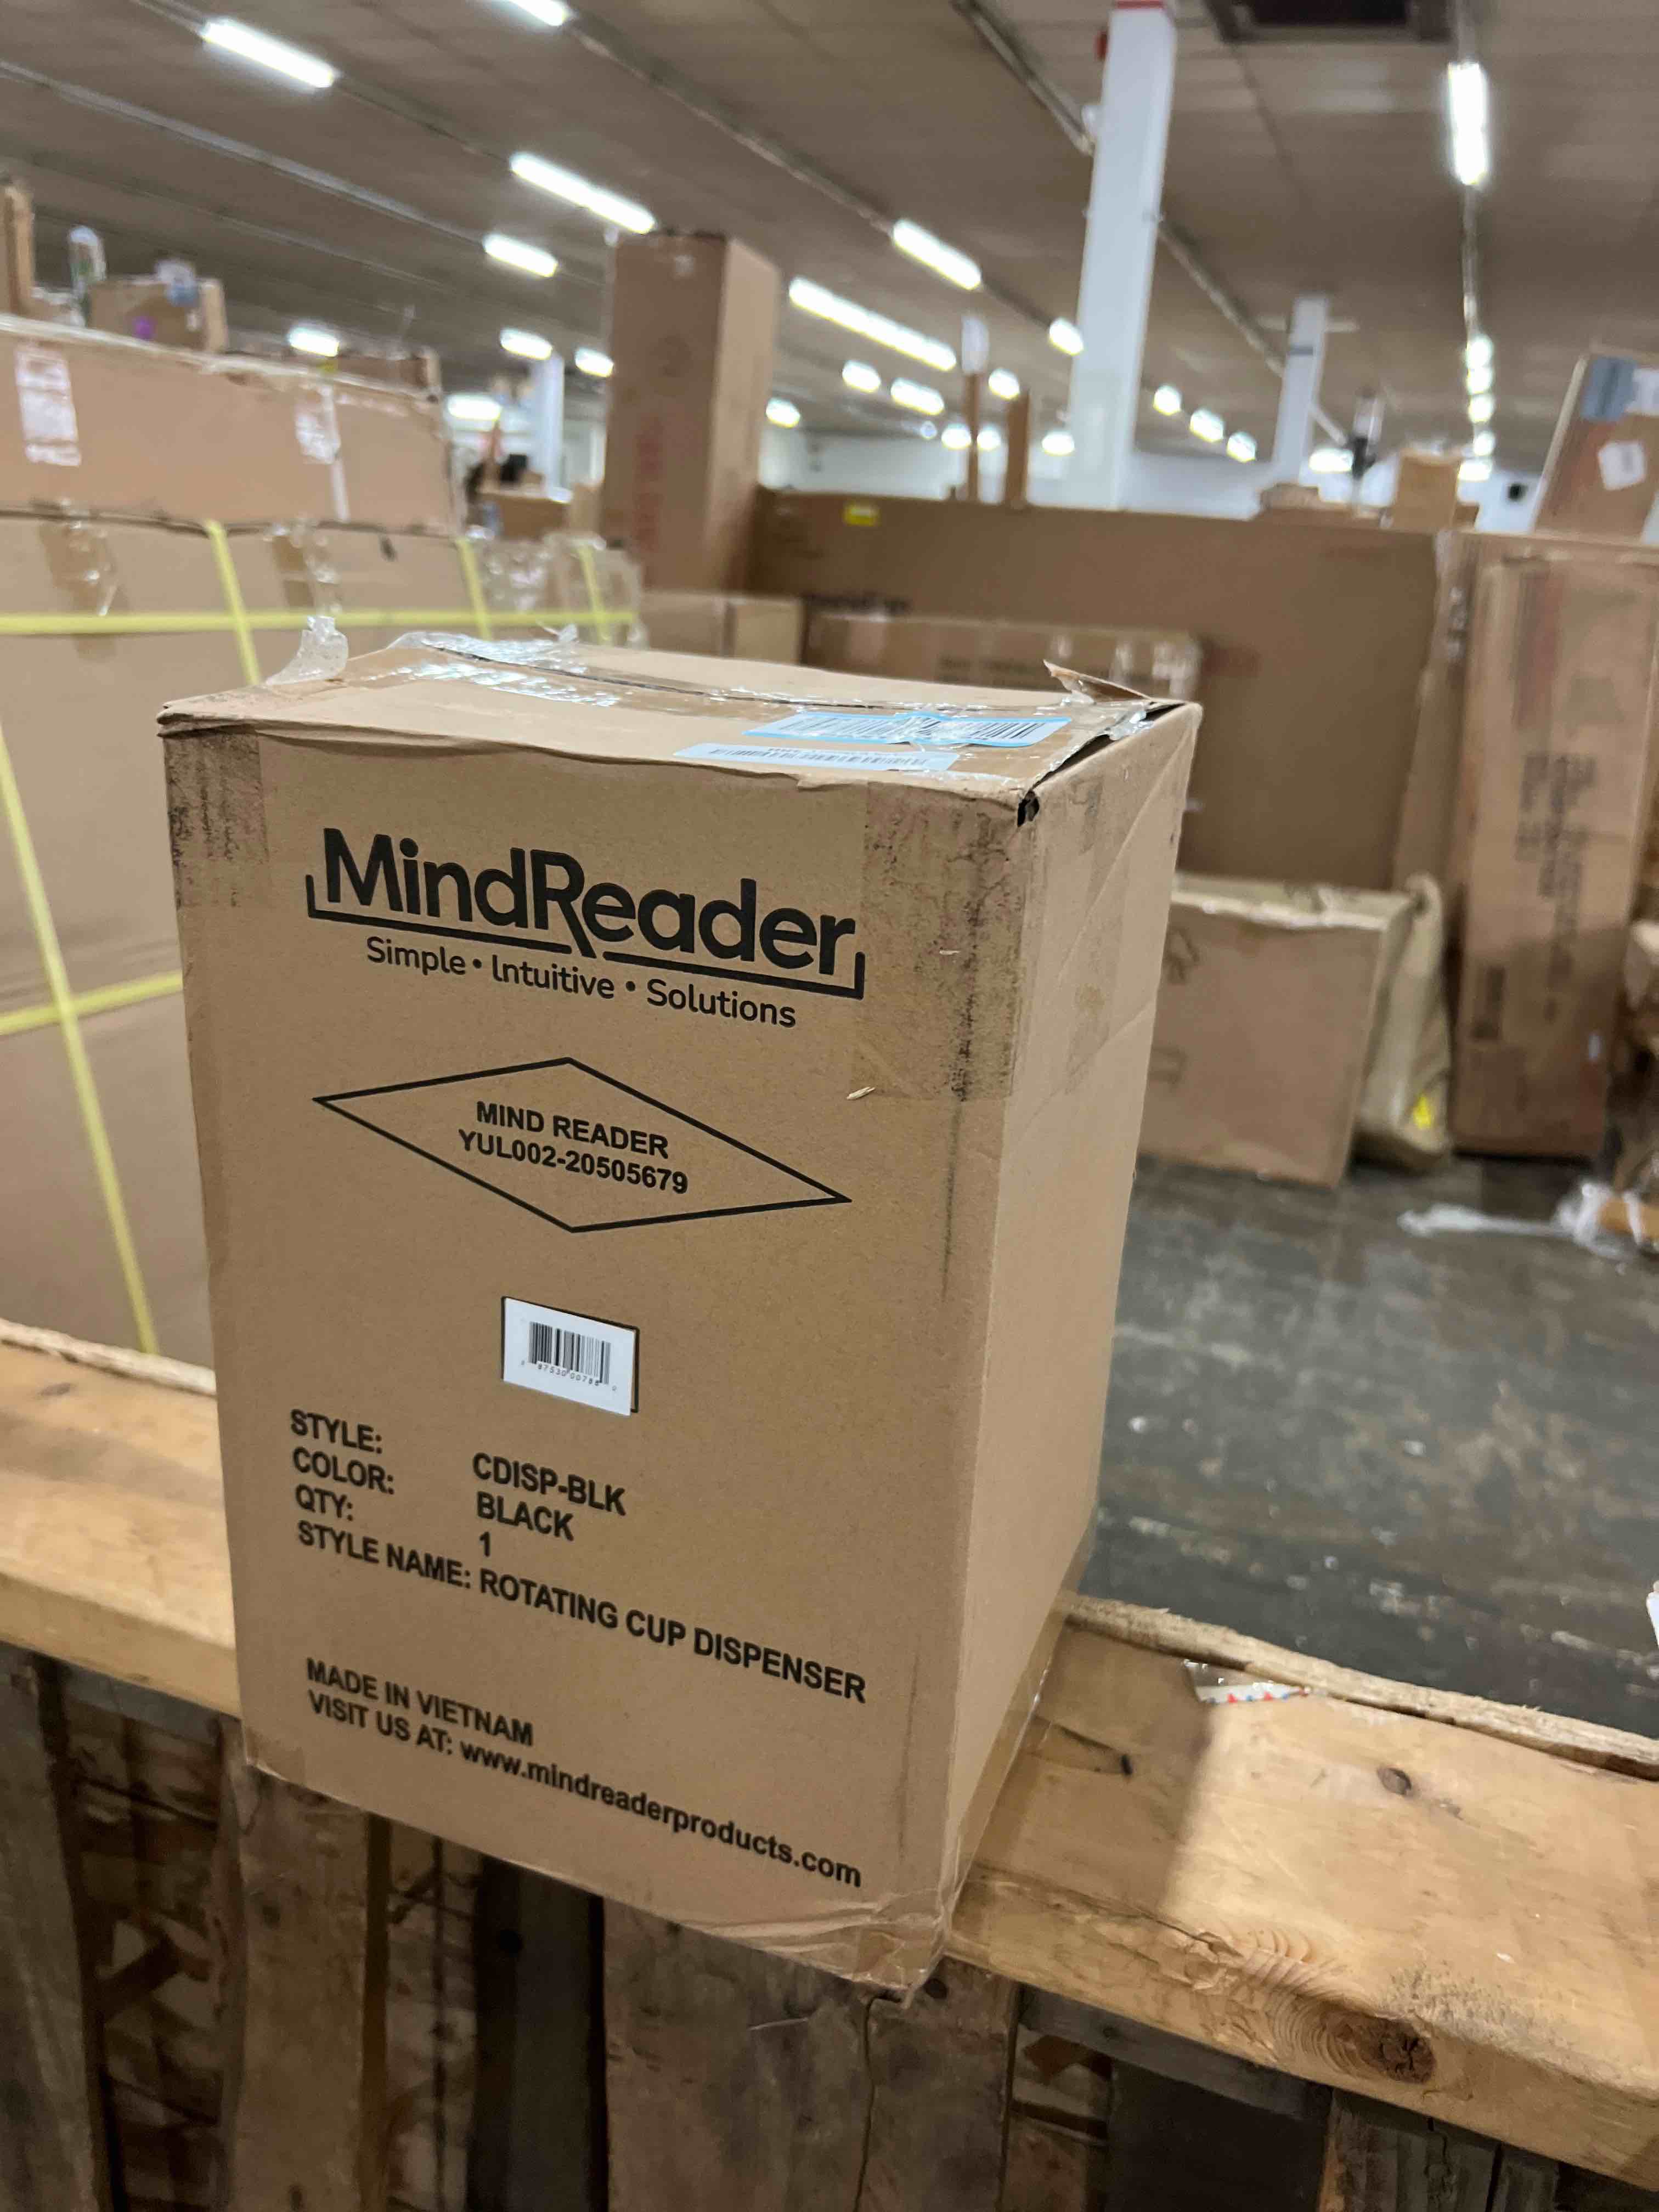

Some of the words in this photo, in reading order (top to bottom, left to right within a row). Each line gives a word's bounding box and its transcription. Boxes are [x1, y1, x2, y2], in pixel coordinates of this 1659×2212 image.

[323, 827, 856, 976] MindReader
[366, 935, 466, 976] Simple
[492, 953, 615, 1000] Intuitive
[647, 978, 797, 1028] Solutions
[458, 1128, 688, 1194] YUL002-20505679
[477, 1100, 545, 1133] MIND
[552, 1114, 669, 1159] READER
[290, 1408, 382, 1454] STYLE:
[472, 1452, 626, 1516] CDISP-BLK
[292, 1446, 394, 1495] COLOR:
[477, 1491, 574, 1542] BLACK
[295, 1483, 353, 1521] QTY:
[479, 1531, 490, 1558] 1
[298, 1520, 380, 1564] STYLE
[387, 1543, 471, 1590] NAME:
[480, 1568, 618, 1629] ROTATING
[625, 1610, 686, 1646] CUP
[693, 1627, 866, 1704] DISPENSER
[307, 1657, 379, 1700] MADE
[385, 1681, 410, 1709] IN
[416, 1690, 533, 1747] VIETNAM
[308, 1689, 369, 1729] VISIT
[376, 1710, 411, 1741] US
[416, 1724, 453, 1755] AT:
[460, 1741, 861, 1888] www.mindreaderproducts.com
